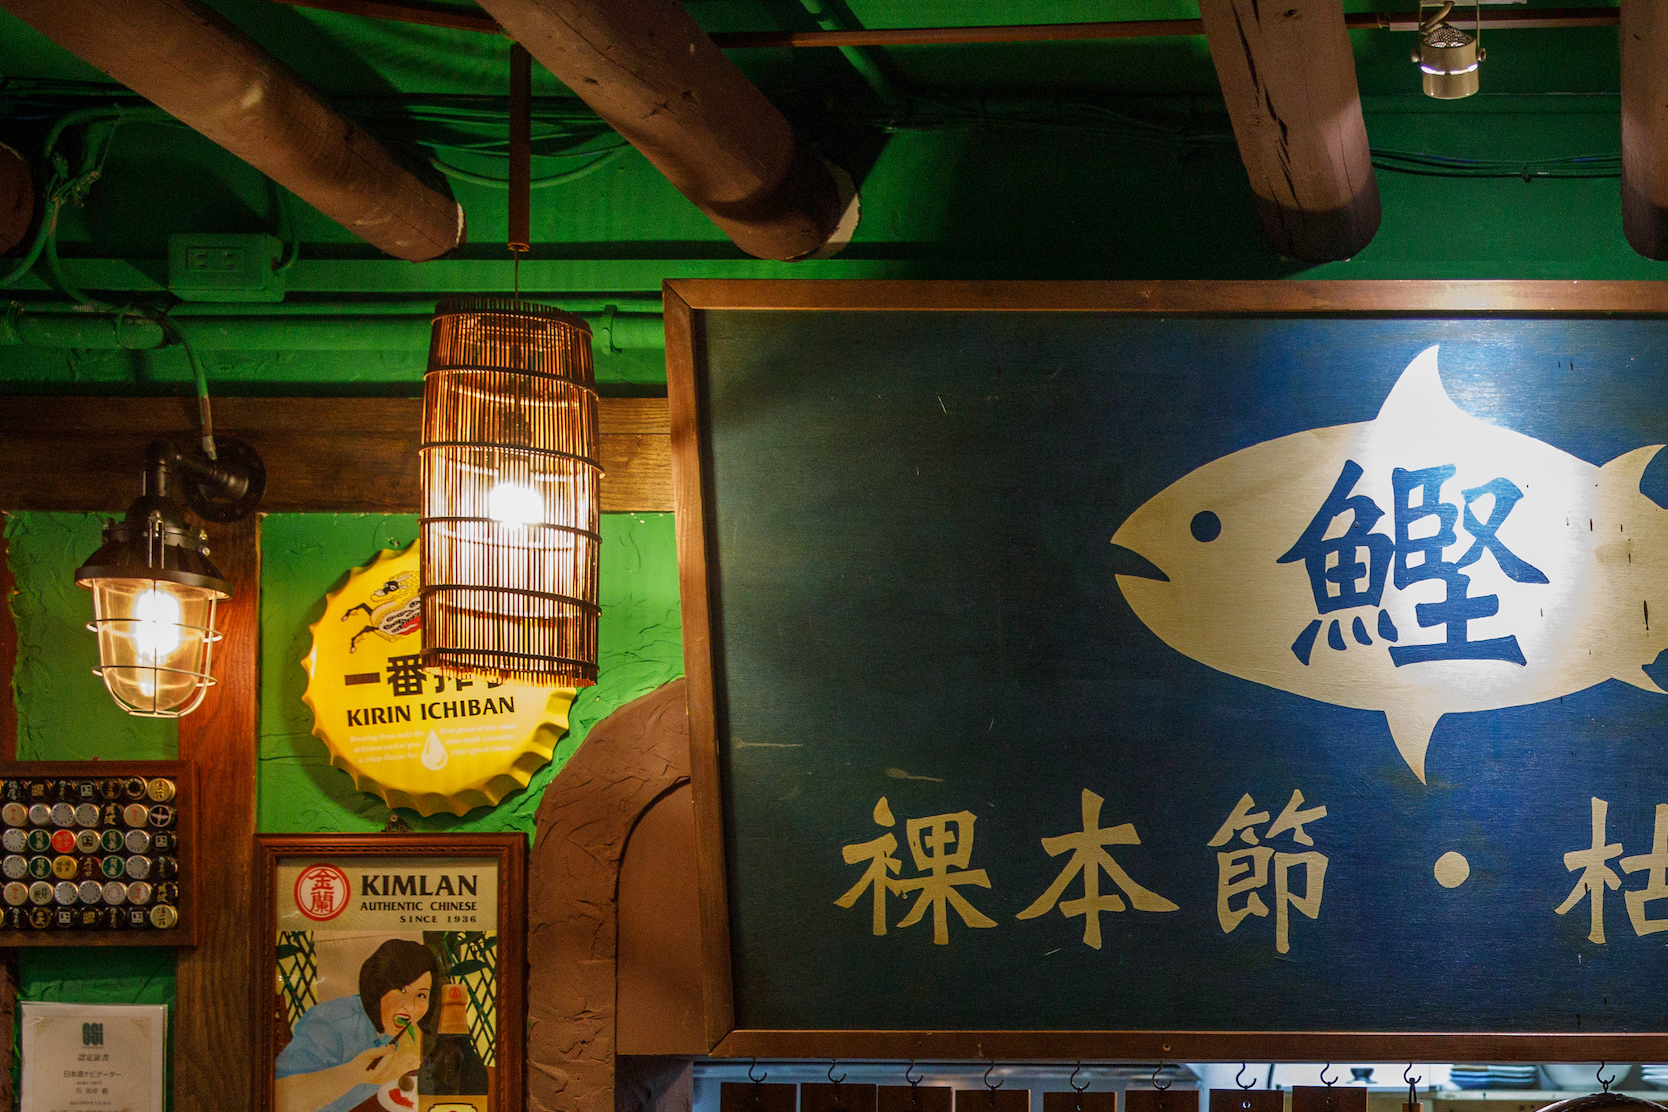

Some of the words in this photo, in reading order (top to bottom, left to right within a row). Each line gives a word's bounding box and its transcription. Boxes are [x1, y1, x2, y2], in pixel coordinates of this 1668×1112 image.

[1276, 459, 1550, 668] 鰹
[347, 705, 411, 727] KIRIN
[420, 696, 515, 721] ICHIBAN
[361, 875, 478, 897] KIMLAN
[360, 901, 424, 912] AUTHENTIC
[430, 901, 478, 912] CHINESE
[400, 915, 438, 923] SINCE
[447, 915, 477, 923] 1936
